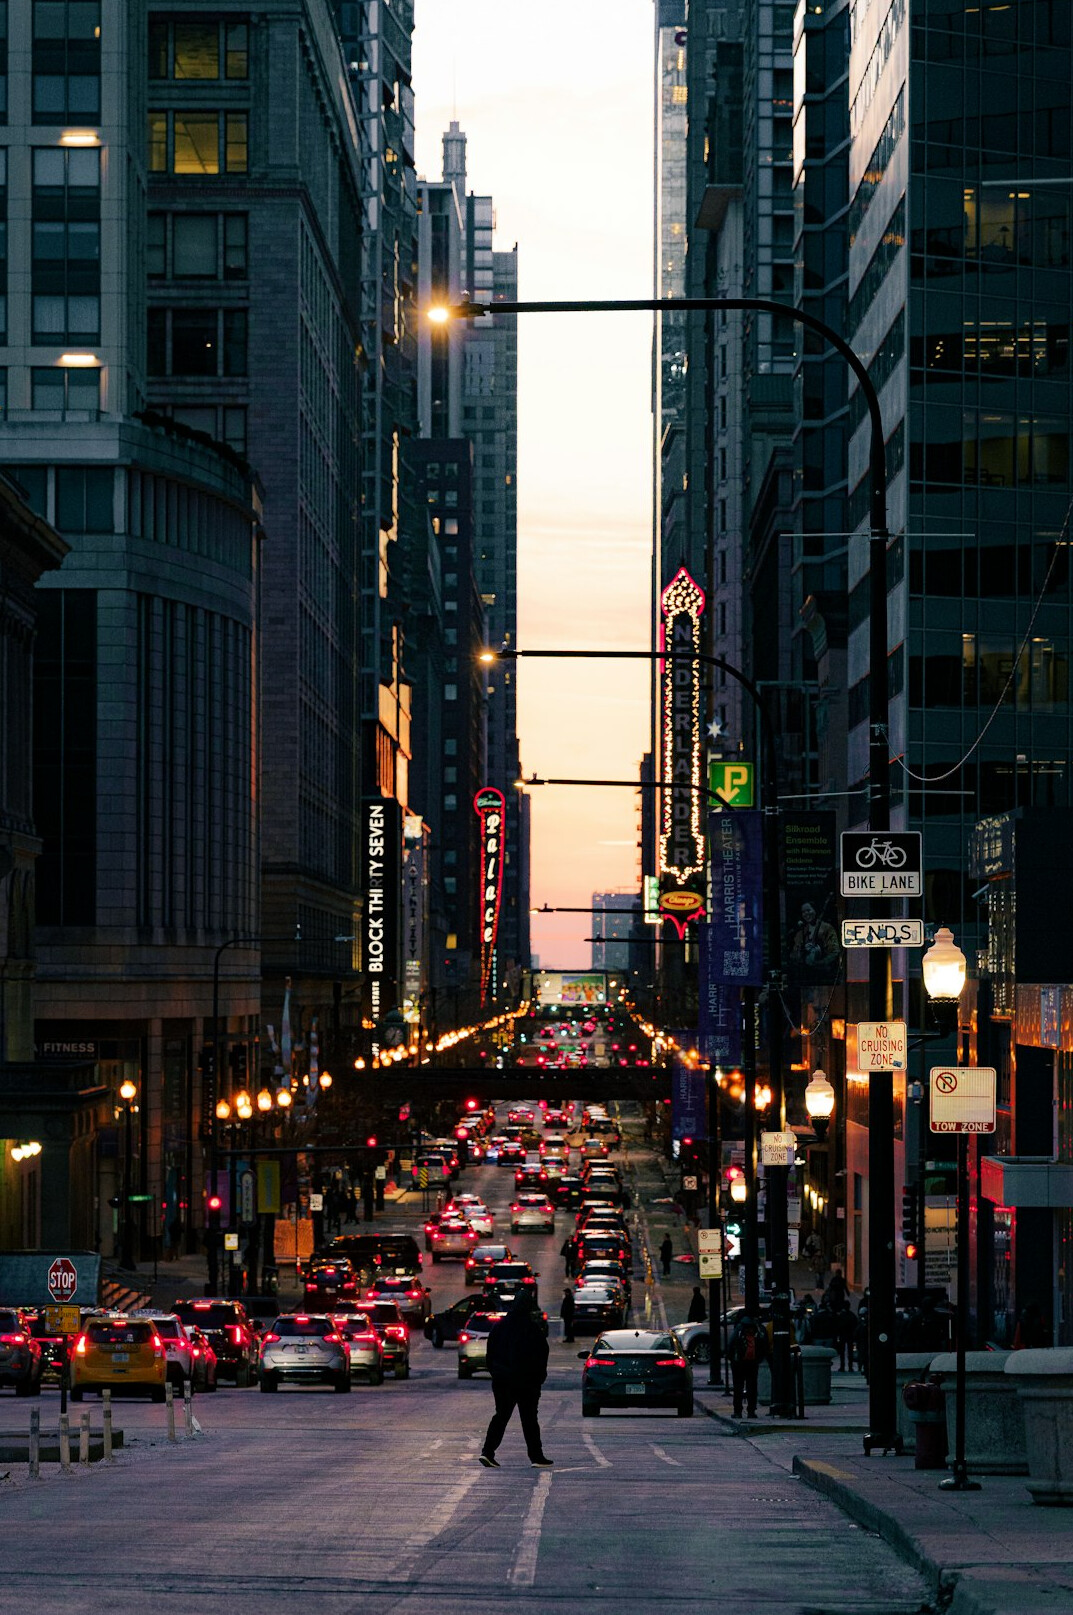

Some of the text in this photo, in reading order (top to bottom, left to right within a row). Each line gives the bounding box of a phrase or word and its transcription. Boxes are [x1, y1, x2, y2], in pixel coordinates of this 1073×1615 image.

[673, 624, 692, 864] NEDERLANDER
[785, 824, 821, 833] Silkroad
[785, 836, 828, 845] Ensemble
[721, 818, 735, 923] HARRIS THEATER
[484, 814, 500, 942] Palace
[848, 876, 914, 889] BIKE LANE
[368, 805, 384, 973] BLOCK THIRTY SEVEN
[854, 925, 912, 942] ENDS
[371, 981, 380, 1005] STATE
[708, 977, 717, 1013] HARR
[876, 1026, 888, 1039] NO
[43, 1042, 95, 1053] FITNESS
[861, 1040, 903, 1052] CRUISING
[870, 1053, 894, 1065] ZONE
[934, 1122, 989, 1131] TOW ZONE
[765, 1144, 793, 1153] CRUISING
[771, 1153, 787, 1161] ZONE
[50, 1271, 75, 1289] STOP
